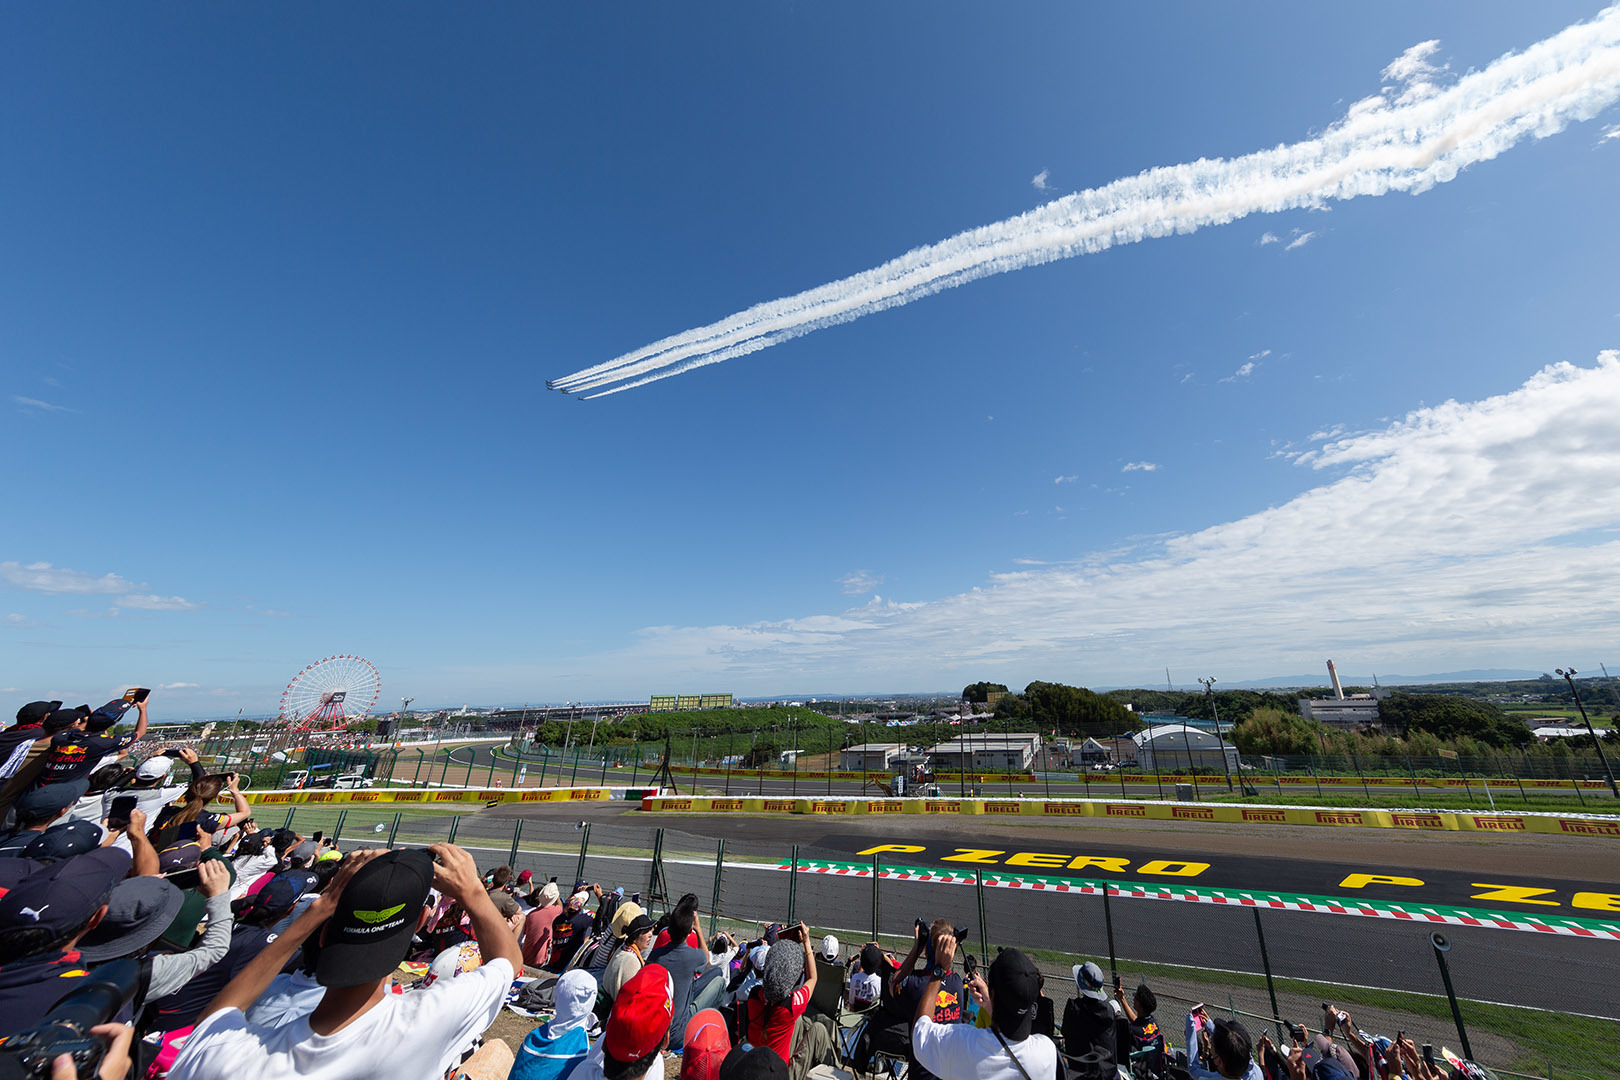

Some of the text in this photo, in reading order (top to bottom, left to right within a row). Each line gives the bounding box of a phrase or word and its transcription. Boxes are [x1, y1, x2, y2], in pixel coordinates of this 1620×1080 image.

[63, 754, 87, 762] Bull
[351, 793, 380, 801] PIRELLI
[394, 793, 422, 801] PIRELLI
[435, 793, 463, 801] PIRELLI
[478, 792, 505, 800] PIRELLI
[521, 792, 552, 801] PIRELLI
[570, 791, 601, 799] PIRELLI
[661, 800, 692, 810] PIRELLI
[711, 800, 744, 810] PIRELLI
[763, 801, 796, 811] PIRELLI
[812, 802, 847, 813] PIRELLI
[868, 802, 903, 812] PIRELLI
[925, 802, 961, 812] PIRELLI
[983, 802, 1020, 813] PIRELLI
[1043, 803, 1081, 814] PIRELLI
[1105, 804, 1146, 816] PIRELLI
[1171, 806, 1214, 819] PIRELLI
[1241, 809, 1287, 822] PIRELLI
[1314, 811, 1364, 825] PIRELLI
[1391, 814, 1443, 828] PIRELLI
[1472, 816, 1526, 830] PIRELLI
[856, 844, 1211, 877] P ZERO
[1338, 873, 1425, 889] P
[343, 926, 370, 934] FORMULA
[387, 918, 405, 929] TEAM
[944, 1006, 960, 1021] Bull
